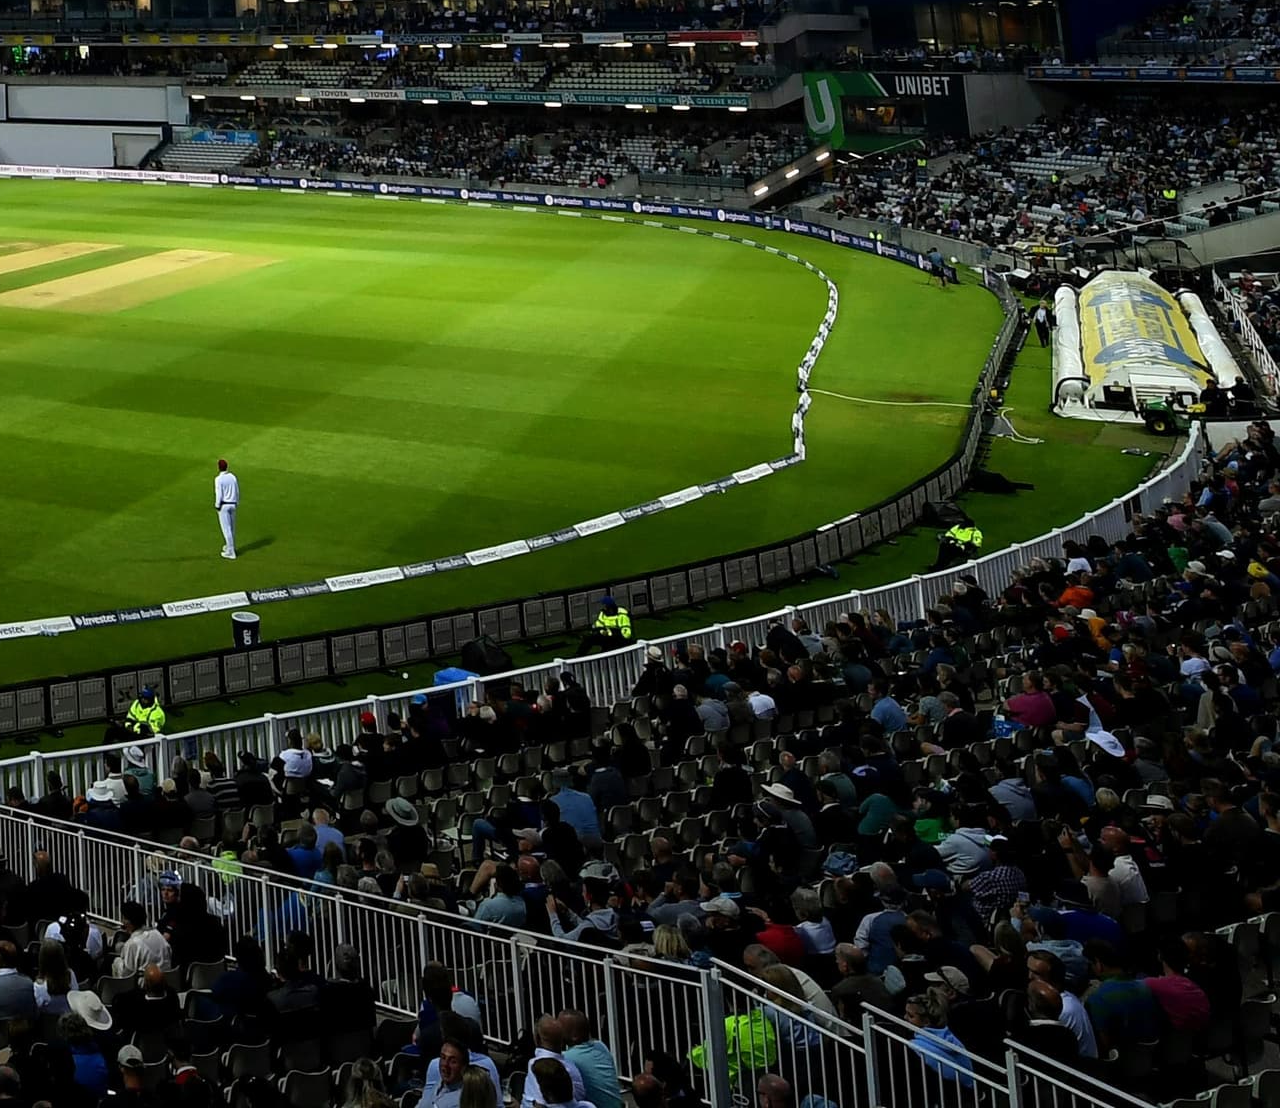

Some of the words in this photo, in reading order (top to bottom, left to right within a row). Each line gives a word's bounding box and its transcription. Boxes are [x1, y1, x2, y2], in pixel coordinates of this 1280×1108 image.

[895, 75, 950, 96] UNIBET
[804, 78, 836, 135] U
[257, 589, 288, 601] Investec
[173, 600, 204, 612] Investec
[83, 613, 117, 626] Investec
